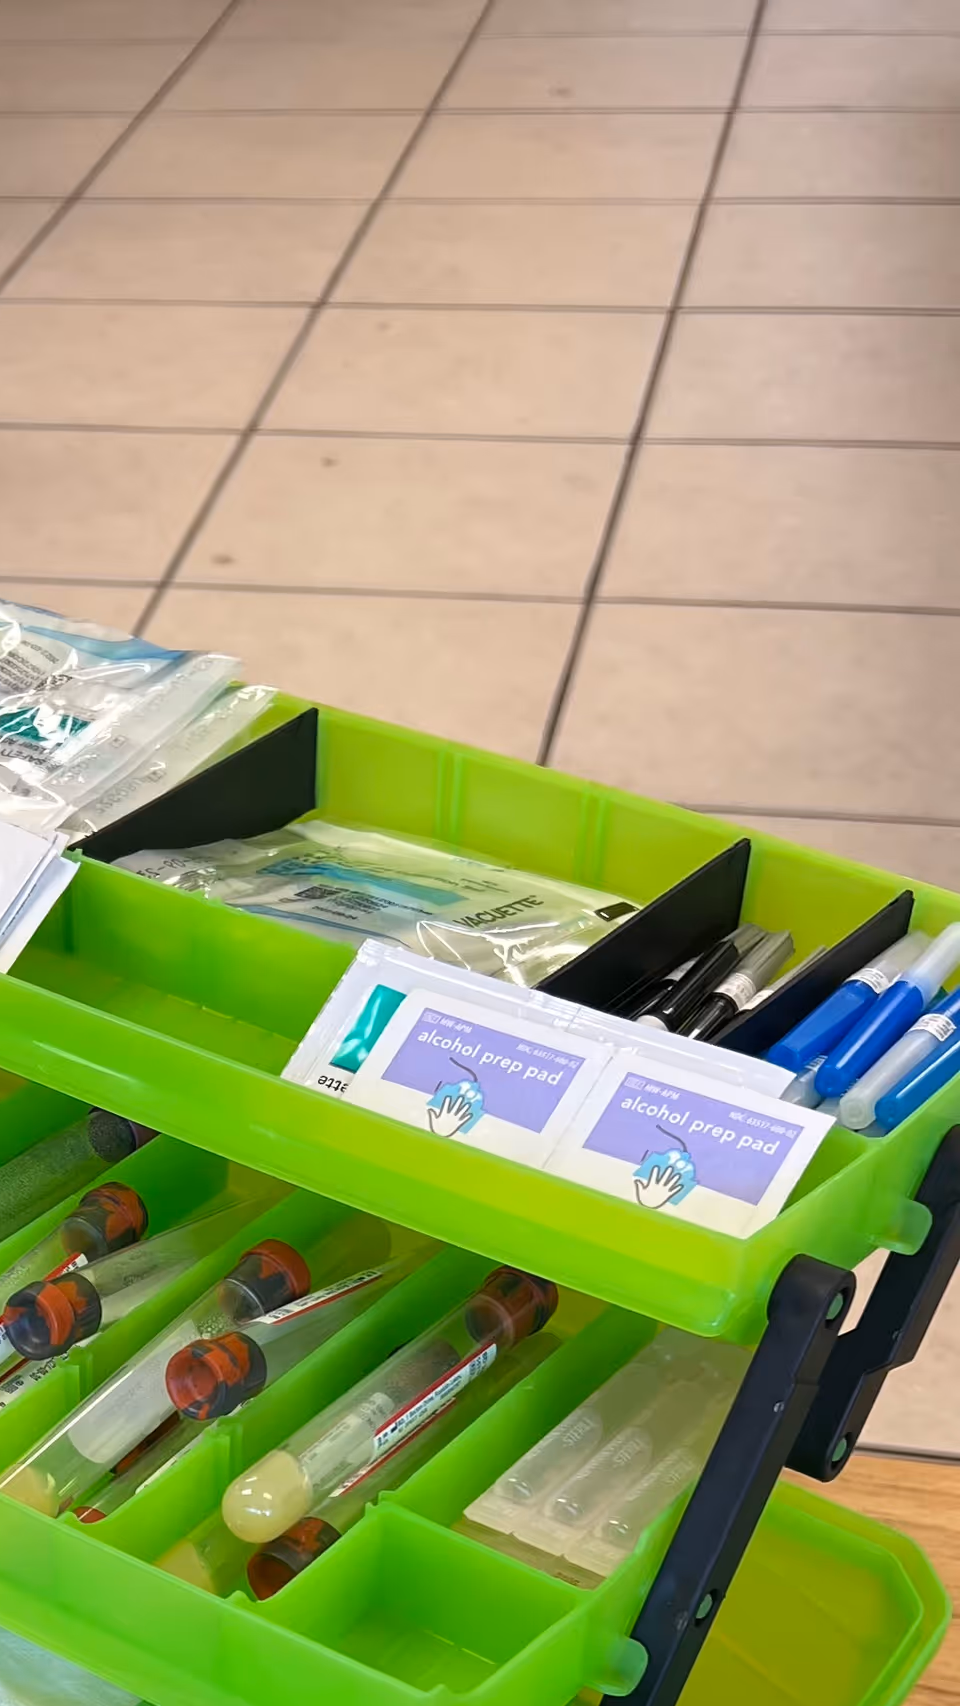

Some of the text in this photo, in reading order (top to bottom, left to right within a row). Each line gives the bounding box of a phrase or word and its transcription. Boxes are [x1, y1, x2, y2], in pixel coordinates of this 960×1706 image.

[455, 895, 543, 931] VACUETTE
[417, 1029, 563, 1087] alcohol prep pad
[620, 1095, 781, 1156] alcohol prep pad
